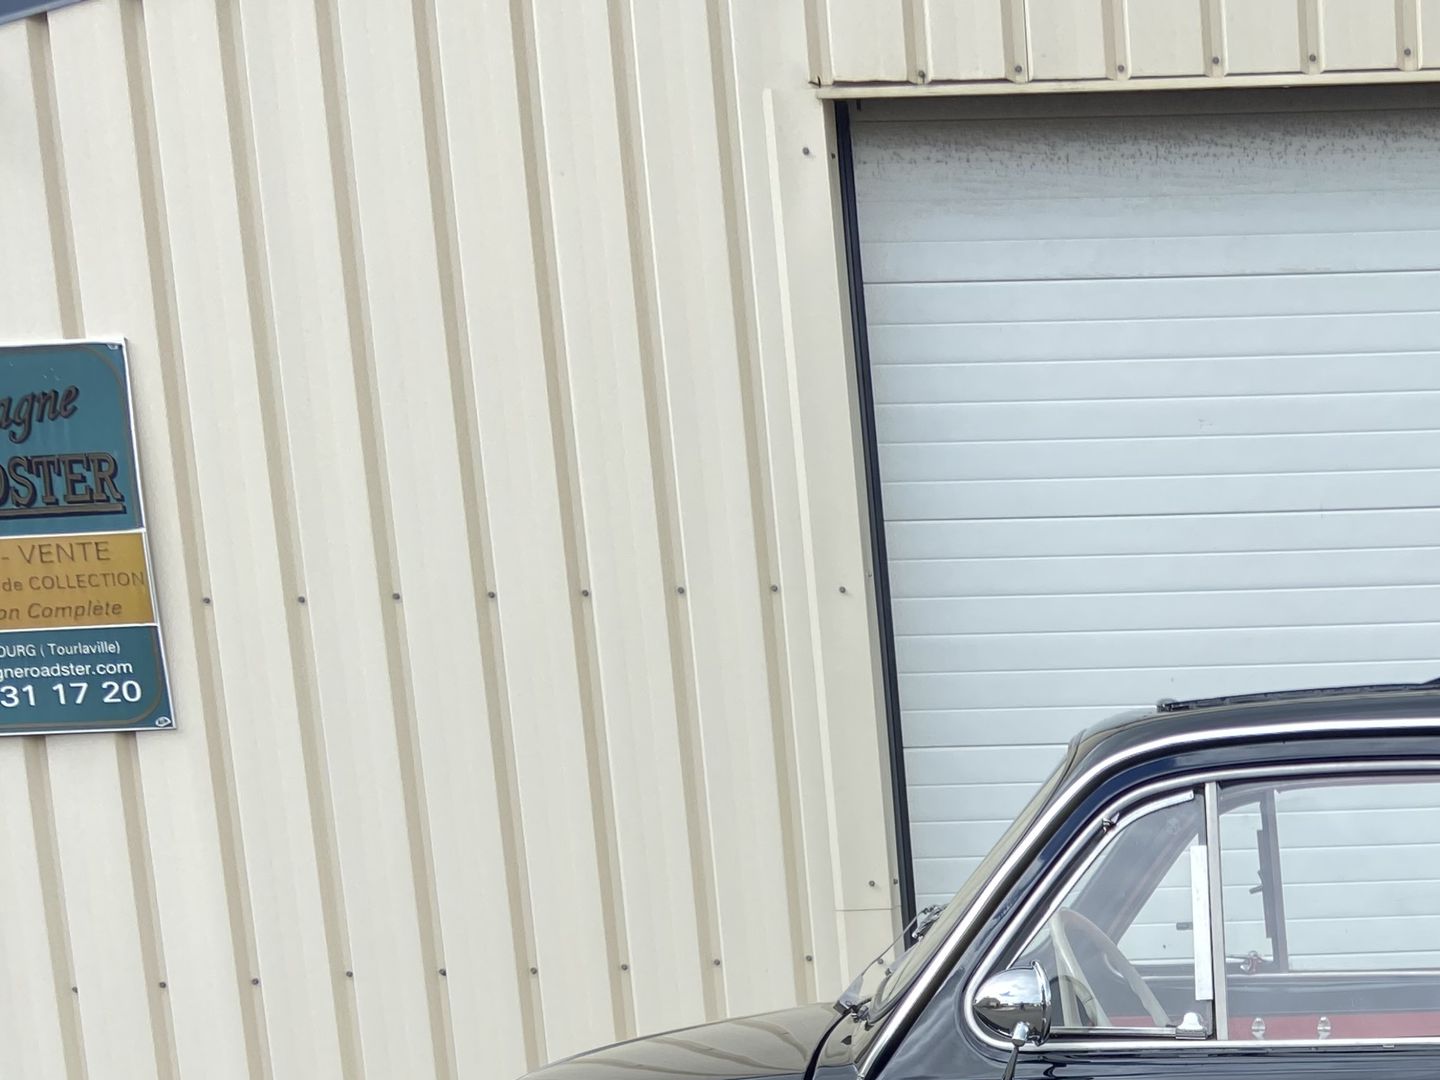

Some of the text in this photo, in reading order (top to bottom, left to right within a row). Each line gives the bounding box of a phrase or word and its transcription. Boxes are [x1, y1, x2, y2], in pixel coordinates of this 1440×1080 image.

[18, 541, 111, 564] VENTE
[2, 572, 145, 592] de COLLECTION
[28, 600, 123, 621] Complète
[1, 680, 142, 708] 31 17 20
